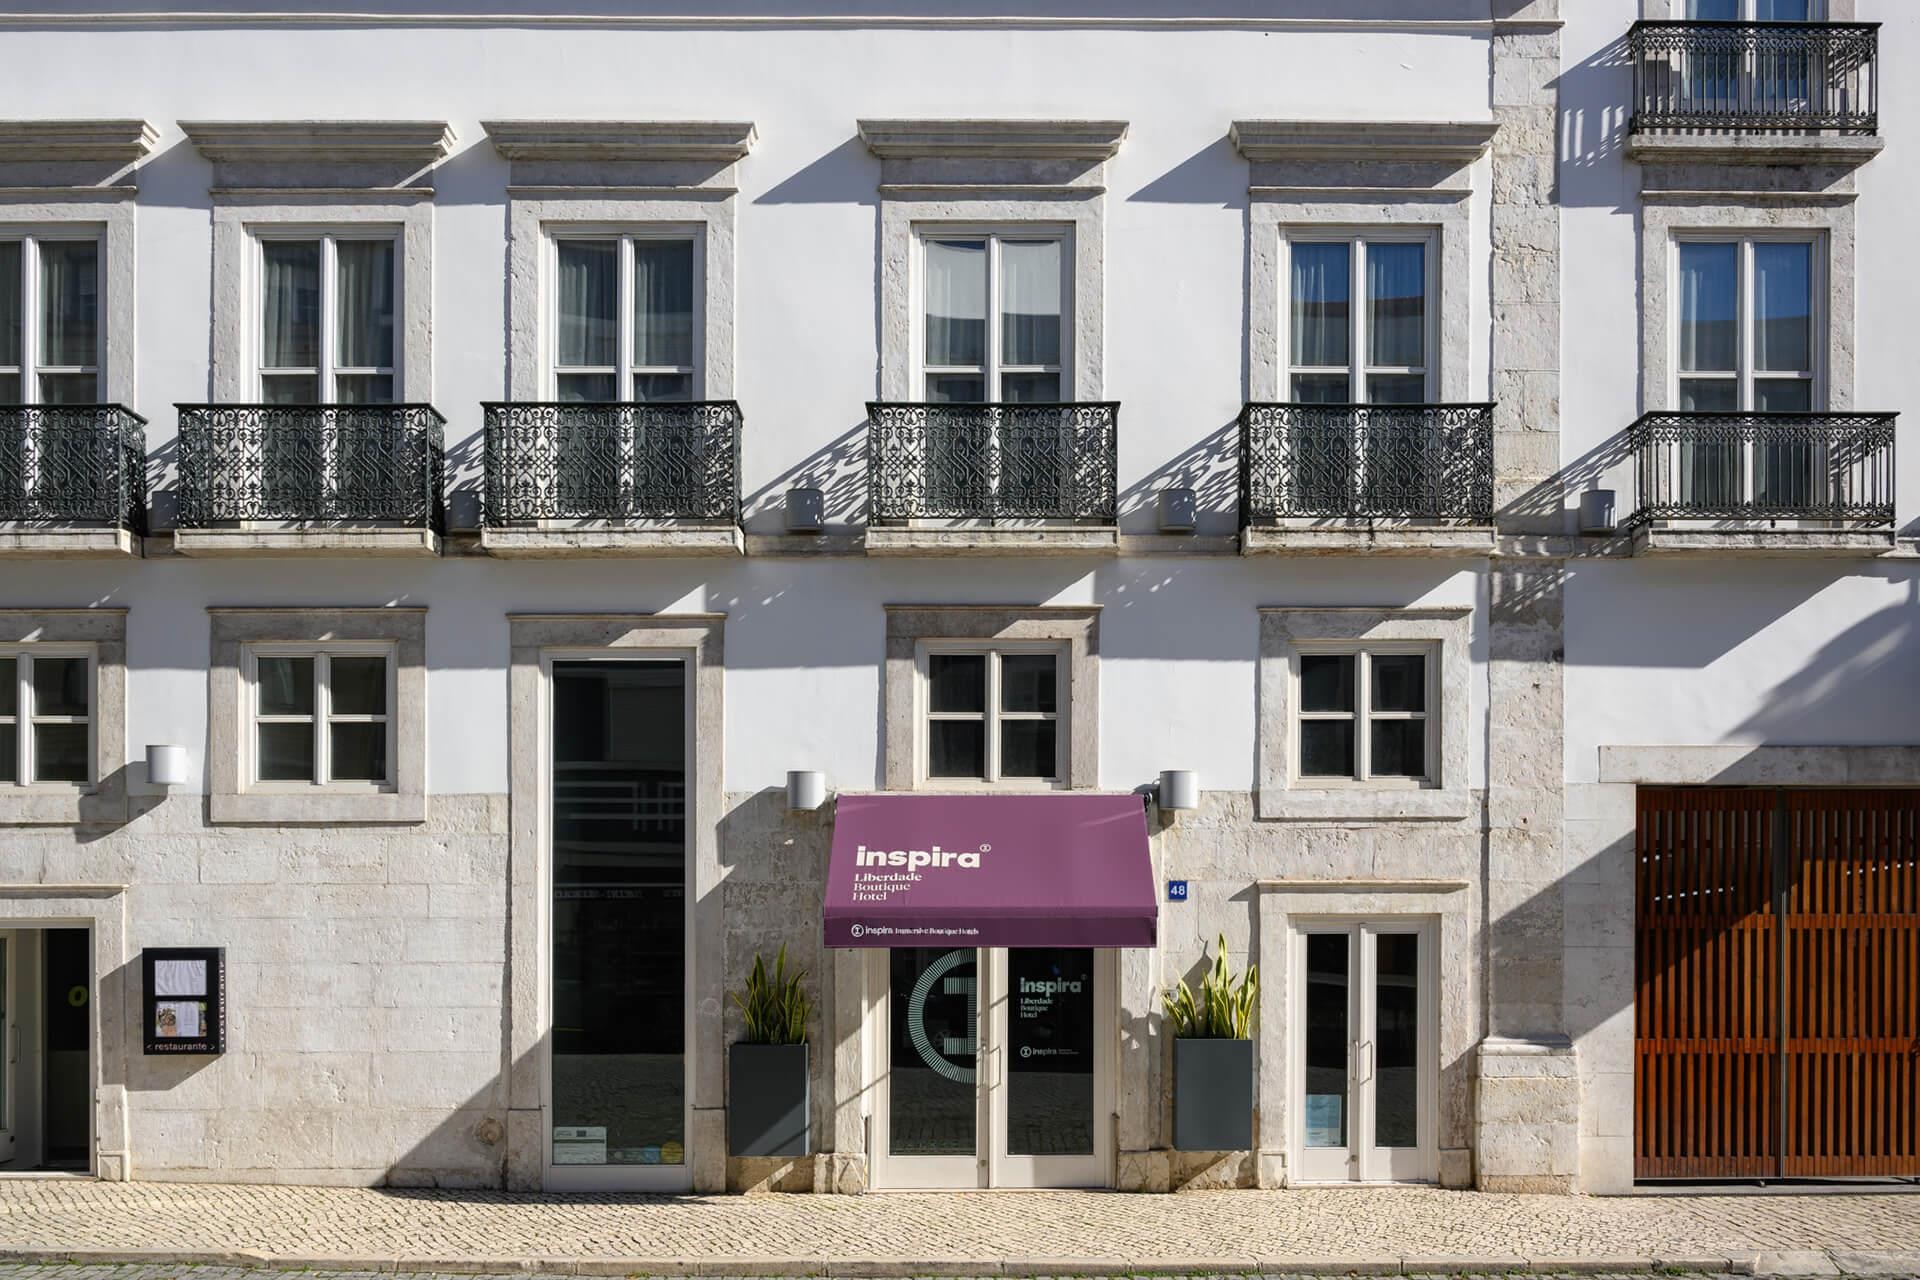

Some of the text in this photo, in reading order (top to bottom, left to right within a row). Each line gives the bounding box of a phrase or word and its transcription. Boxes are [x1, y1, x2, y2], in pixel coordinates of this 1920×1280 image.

[856, 845, 980, 872] inspira
[855, 873, 922, 882] Liberdade
[854, 882, 911, 893] Boutique
[1170, 885, 1185, 896] 48
[853, 892, 887, 901] Hotel
[865, 926, 893, 935] inspira
[1020, 976, 1082, 997] inspira
[154, 1043, 207, 1051] restaurante
[1032, 1047, 1057, 1056] inspira
